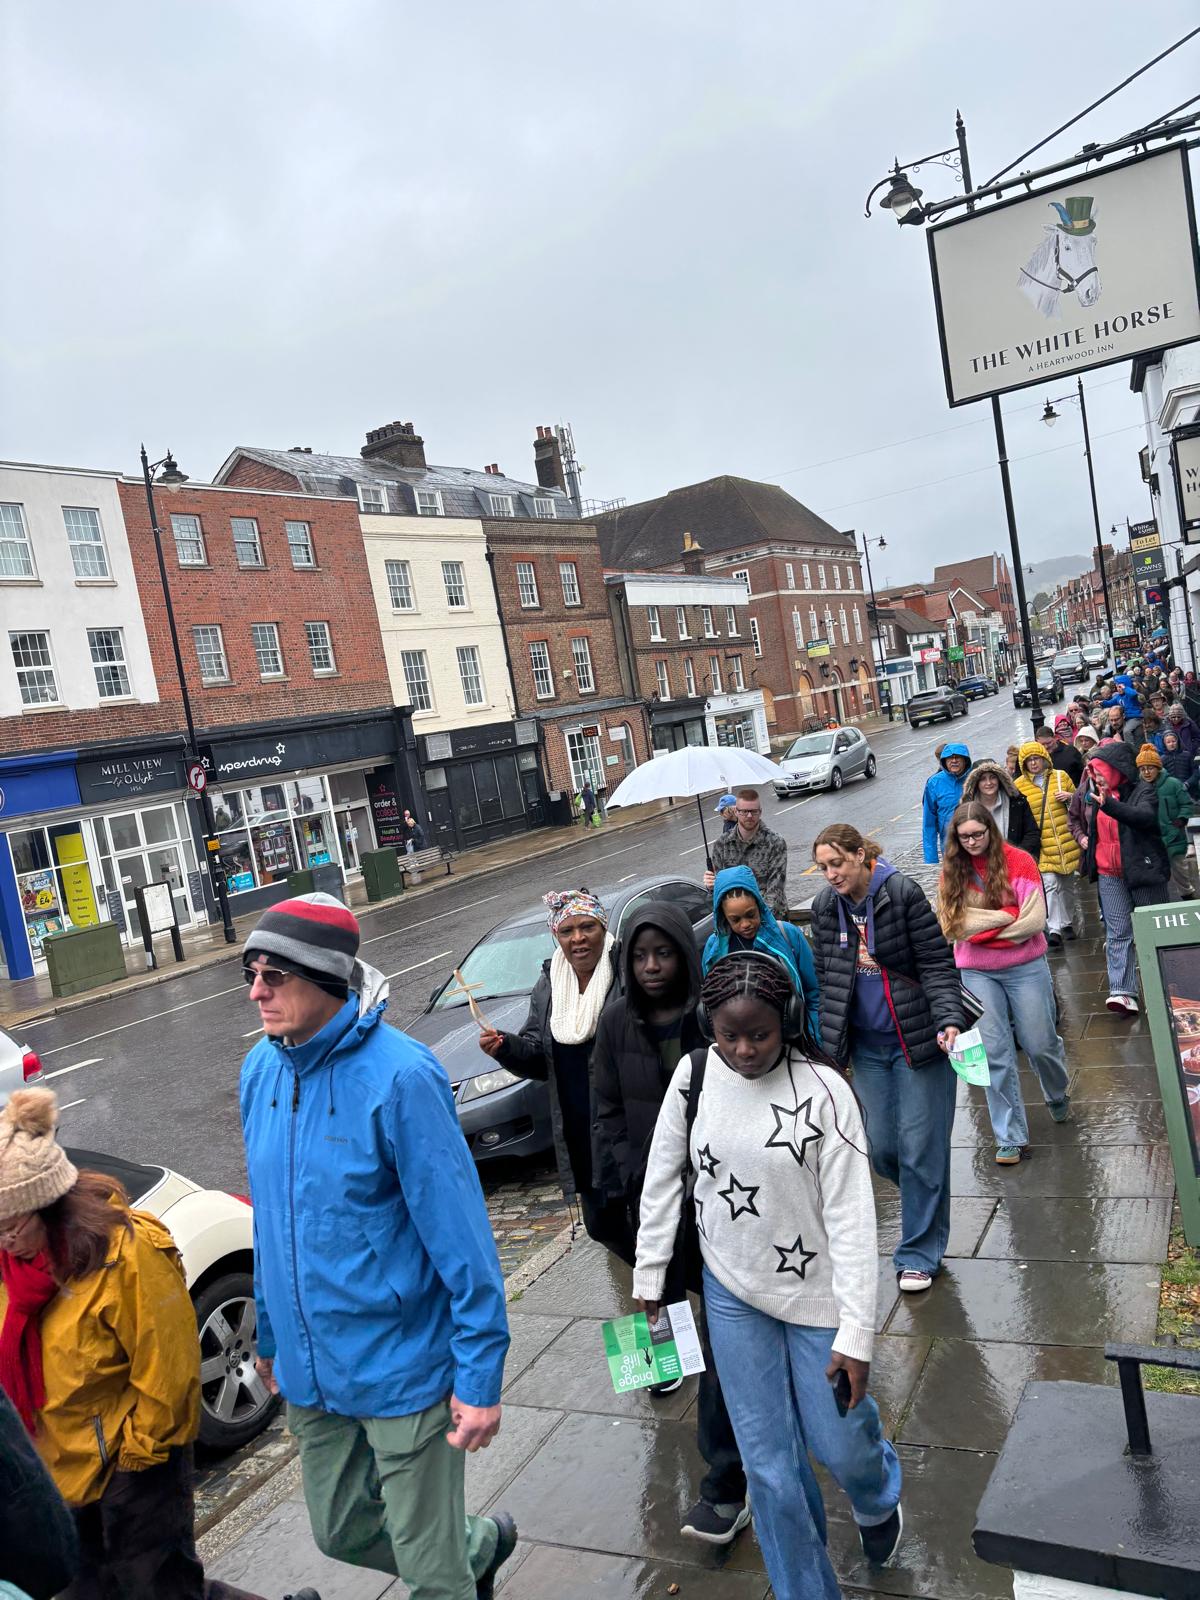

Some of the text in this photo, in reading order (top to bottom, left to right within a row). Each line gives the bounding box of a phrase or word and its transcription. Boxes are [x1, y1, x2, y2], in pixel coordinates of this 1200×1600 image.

[969, 301, 1175, 374] THE WHITE HORSE
[1028, 343, 1114, 373] A HEARTWOOD INN
[1144, 536, 1156, 544] Let
[1136, 562, 1162, 573] DOWNS
[101, 758, 163, 776] MILL VIEW
[374, 797, 397, 808] order &
[376, 807, 398, 817] collect
[40, 896, 50, 905] £4
[1151, 912, 1190, 929] THE
[623, 1352, 641, 1368] life
[619, 1371, 655, 1388] bridge
